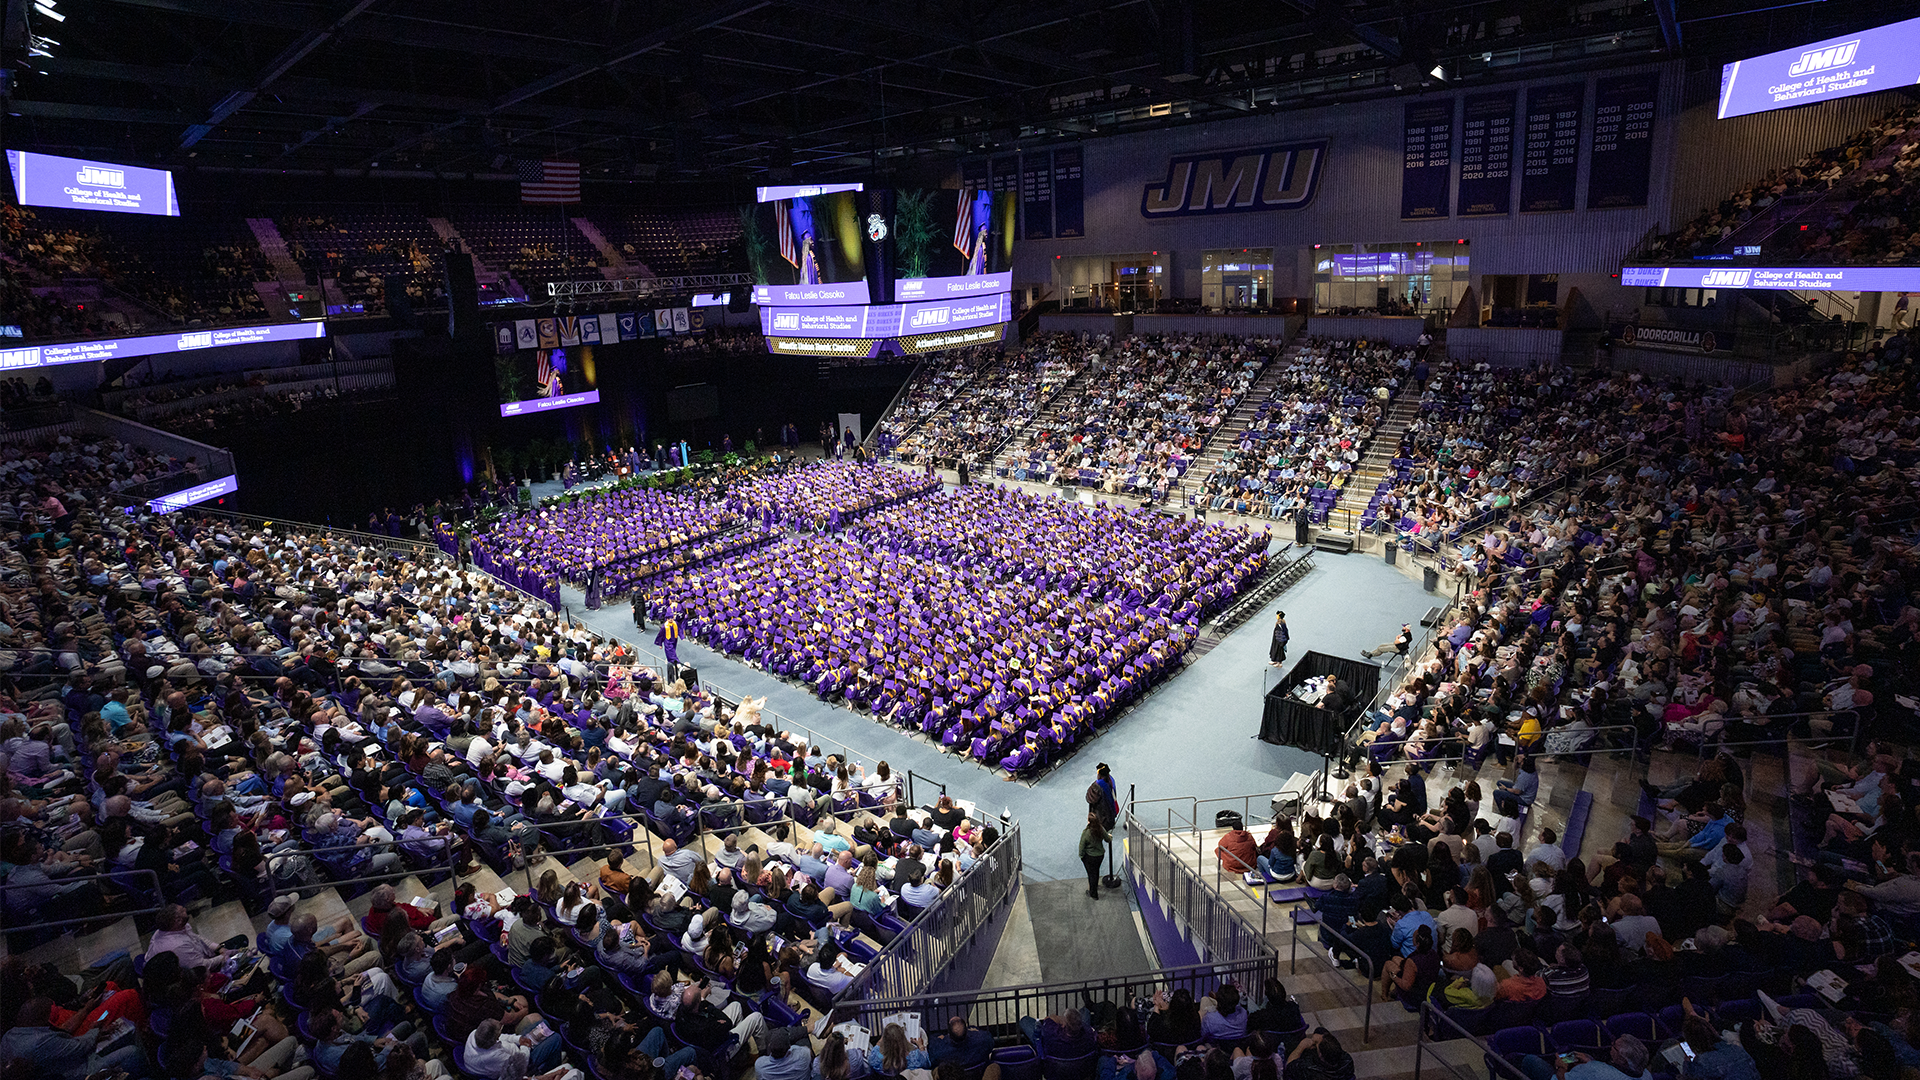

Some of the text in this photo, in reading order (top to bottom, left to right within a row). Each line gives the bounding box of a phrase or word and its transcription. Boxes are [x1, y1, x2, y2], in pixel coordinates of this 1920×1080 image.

[1790, 42, 1857, 76] JMU
[1768, 65, 1875, 95] College of Health and
[1774, 78, 1868, 102] Behavioral Studies
[1597, 102, 1653, 114] 2001 2006
[1556, 111, 1576, 119] 1987
[1597, 112, 1652, 124] 2008 2009
[1626, 122, 1649, 130] 2013
[1625, 131, 1648, 139] 2018
[78, 167, 123, 188] JMU
[1145, 148, 1320, 213] JMU
[64, 187, 92, 197] College
[102, 191, 126, 199] Health
[72, 195, 140, 208] Behavioral Studies
[1702, 270, 1750, 287] JMU
[1754, 271, 1783, 280] College
[1794, 271, 1823, 279] Health
[947, 280, 1000, 291] Fatou Leslie Cissoko
[785, 291, 844, 300] Fatou Leslie Cissoko
[774, 314, 799, 329] JMU
[911, 308, 949, 327] JMU
[178, 333, 211, 350] JMU
[916, 338, 944, 348] Atlantic
[945, 335, 964, 344] Union
[964, 333, 978, 341] Bank
[1637, 327, 1699, 344] DOORGORILLA
[44, 348, 71, 356] College
[81, 344, 104, 352] Health
[46, 353, 86, 363] Behavioral
[567, 396, 585, 404] Cissoko
